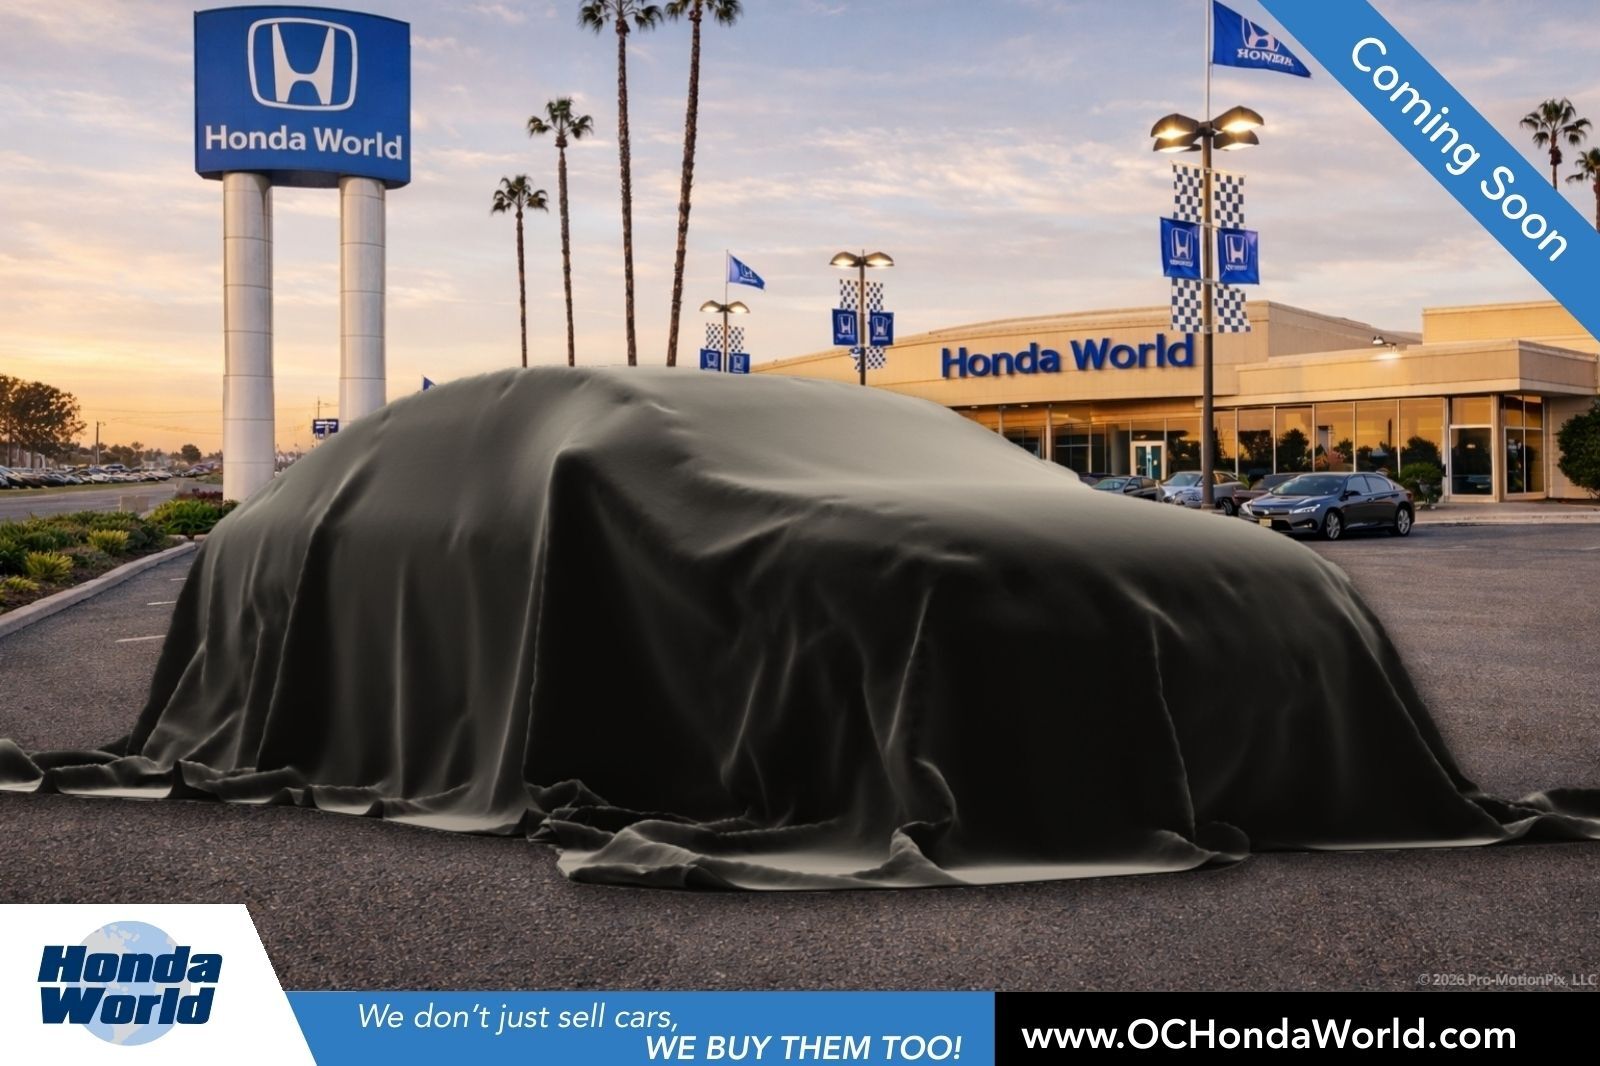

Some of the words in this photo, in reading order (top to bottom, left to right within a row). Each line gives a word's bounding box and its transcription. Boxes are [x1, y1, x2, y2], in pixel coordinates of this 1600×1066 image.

[205, 125, 306, 150] Honda
[313, 127, 402, 160] World
[941, 342, 1062, 379] Honda
[1070, 333, 1194, 371] World
